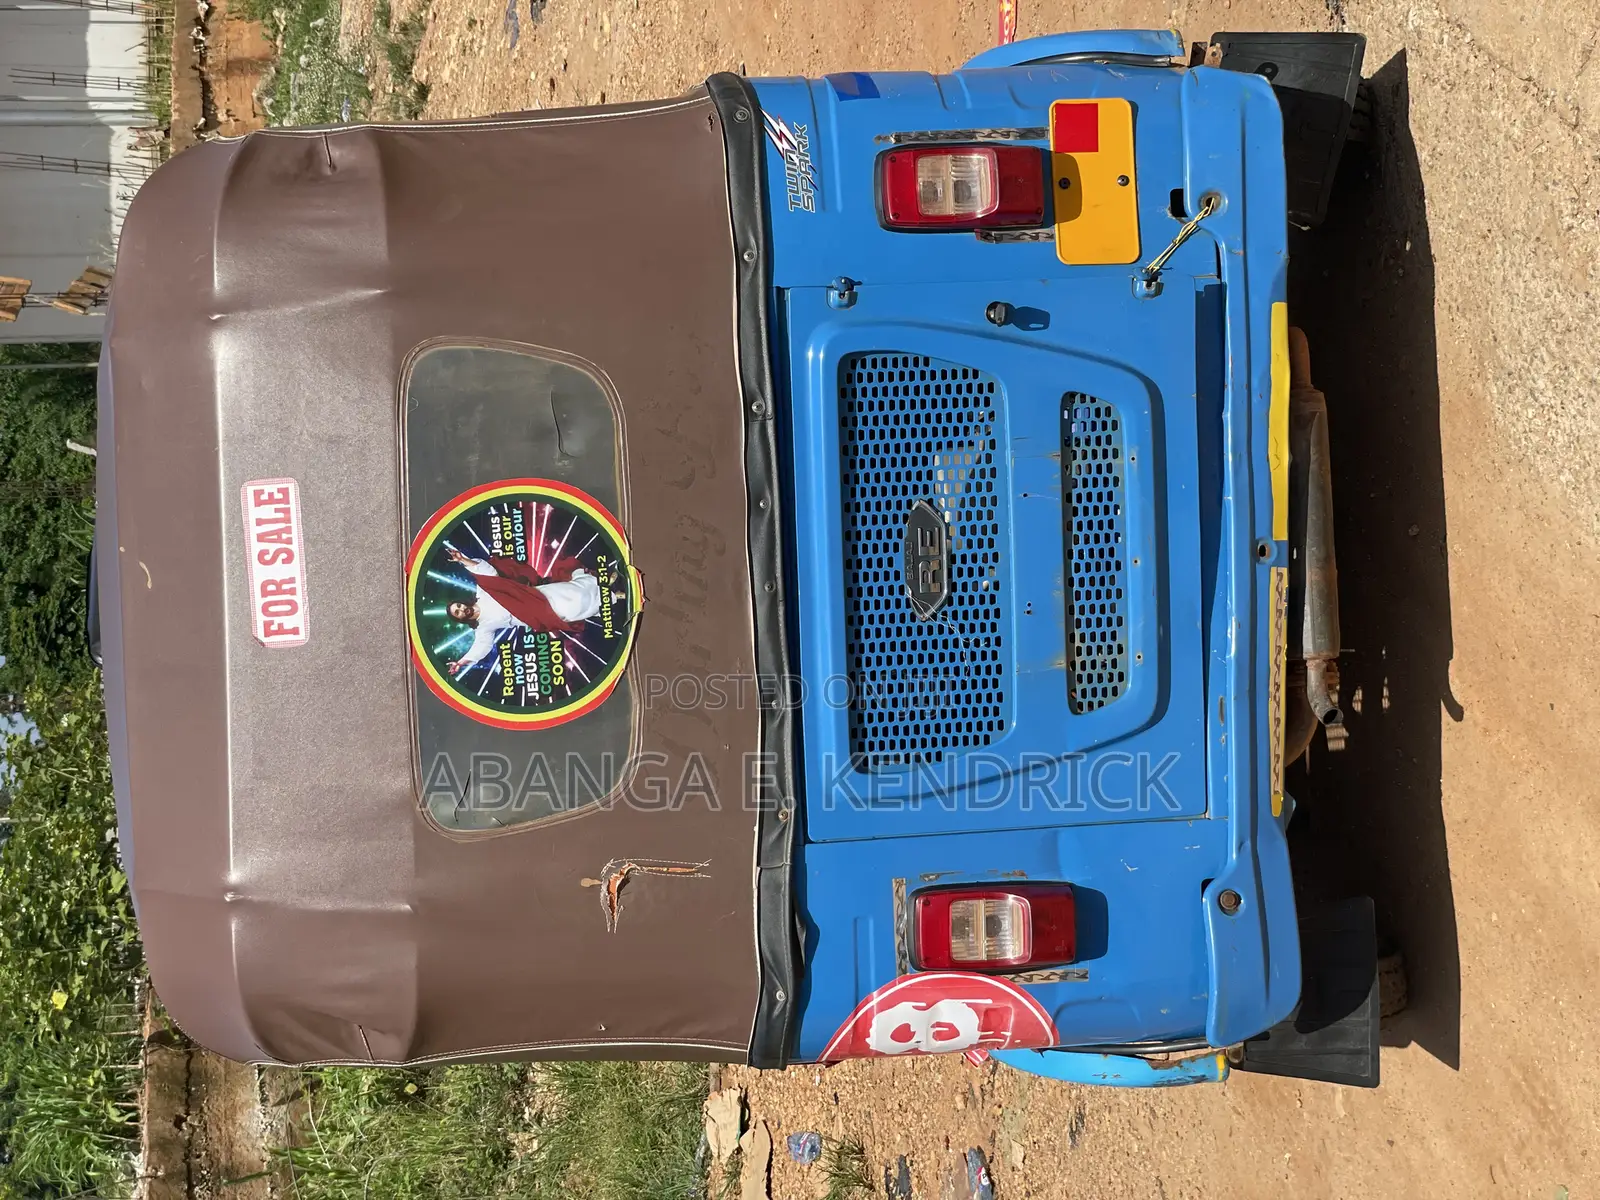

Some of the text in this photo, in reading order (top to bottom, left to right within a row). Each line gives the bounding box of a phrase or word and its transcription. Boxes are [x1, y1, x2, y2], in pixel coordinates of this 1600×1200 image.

[784, 148, 802, 212] TWIN
[793, 121, 816, 214] SPARK
[253, 487, 300, 638] FOR SALE
[490, 515, 503, 557] Jesus
[502, 515, 514, 556] is our
[512, 508, 526, 562] saviour
[905, 541, 914, 580] BAJAJ
[917, 526, 942, 594] RE
[597, 554, 614, 640] Matthew 3:1-2
[500, 642, 515, 697] Repent
[513, 653, 525, 685] now
[523, 632, 540, 700] JESUS IS
[536, 632, 552, 695] COMING
[551, 639, 565, 686] SOON
